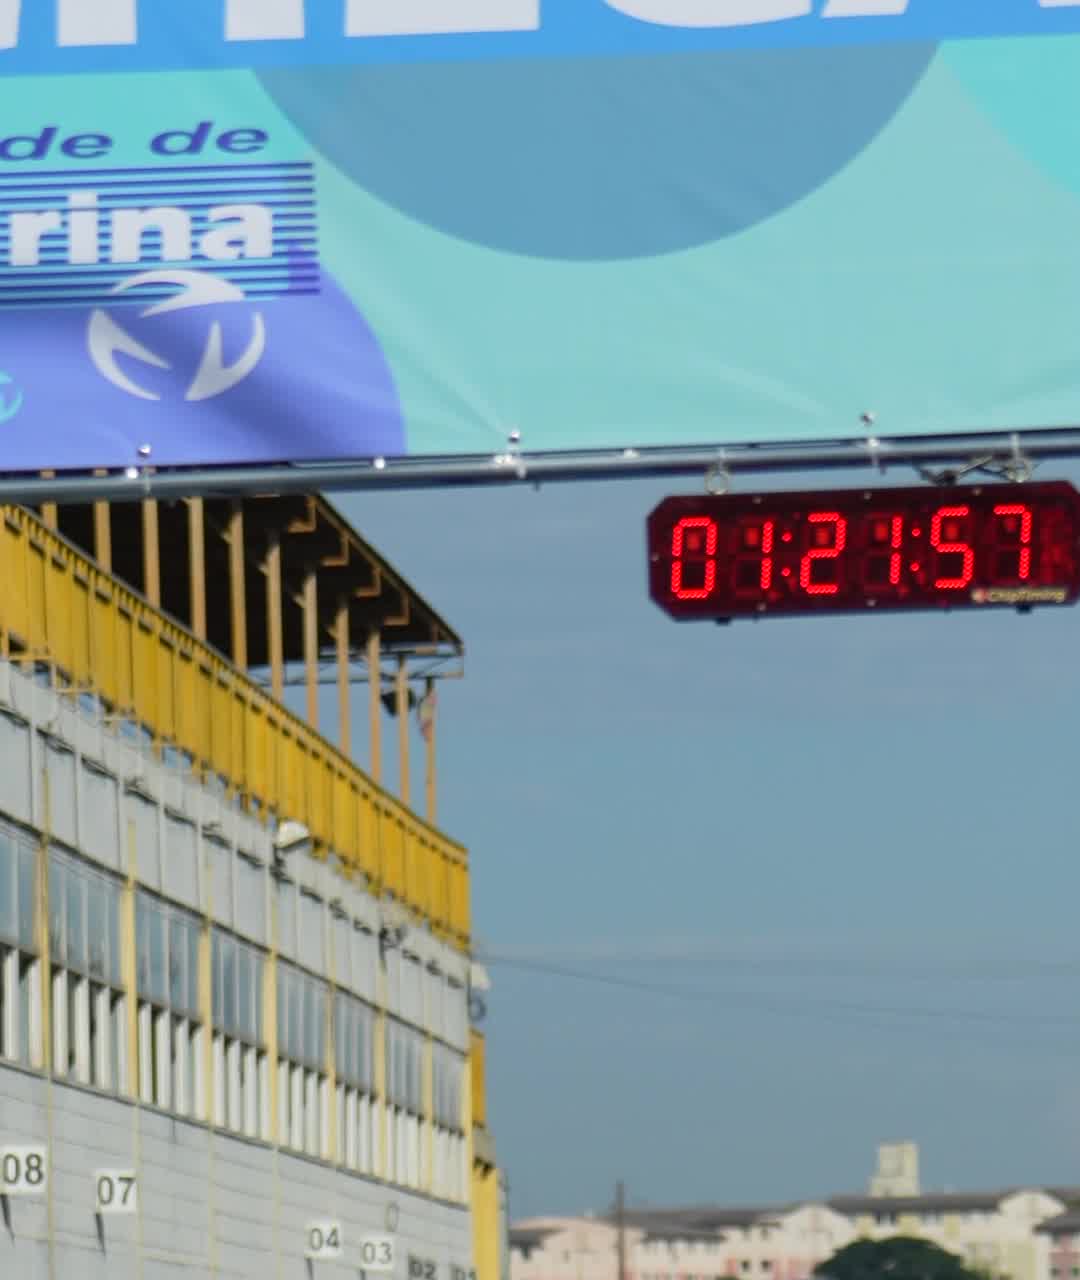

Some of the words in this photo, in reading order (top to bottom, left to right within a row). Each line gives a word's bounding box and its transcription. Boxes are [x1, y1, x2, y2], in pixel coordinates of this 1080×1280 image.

[150, 121, 270, 156] de
[9, 191, 274, 267] rina
[670, 504, 1033, 600] 01:21:57
[2, 1152, 44, 1186] 08
[97, 1175, 137, 1205] 07
[310, 1227, 339, 1251] 04
[362, 1242, 392, 1265] 03
